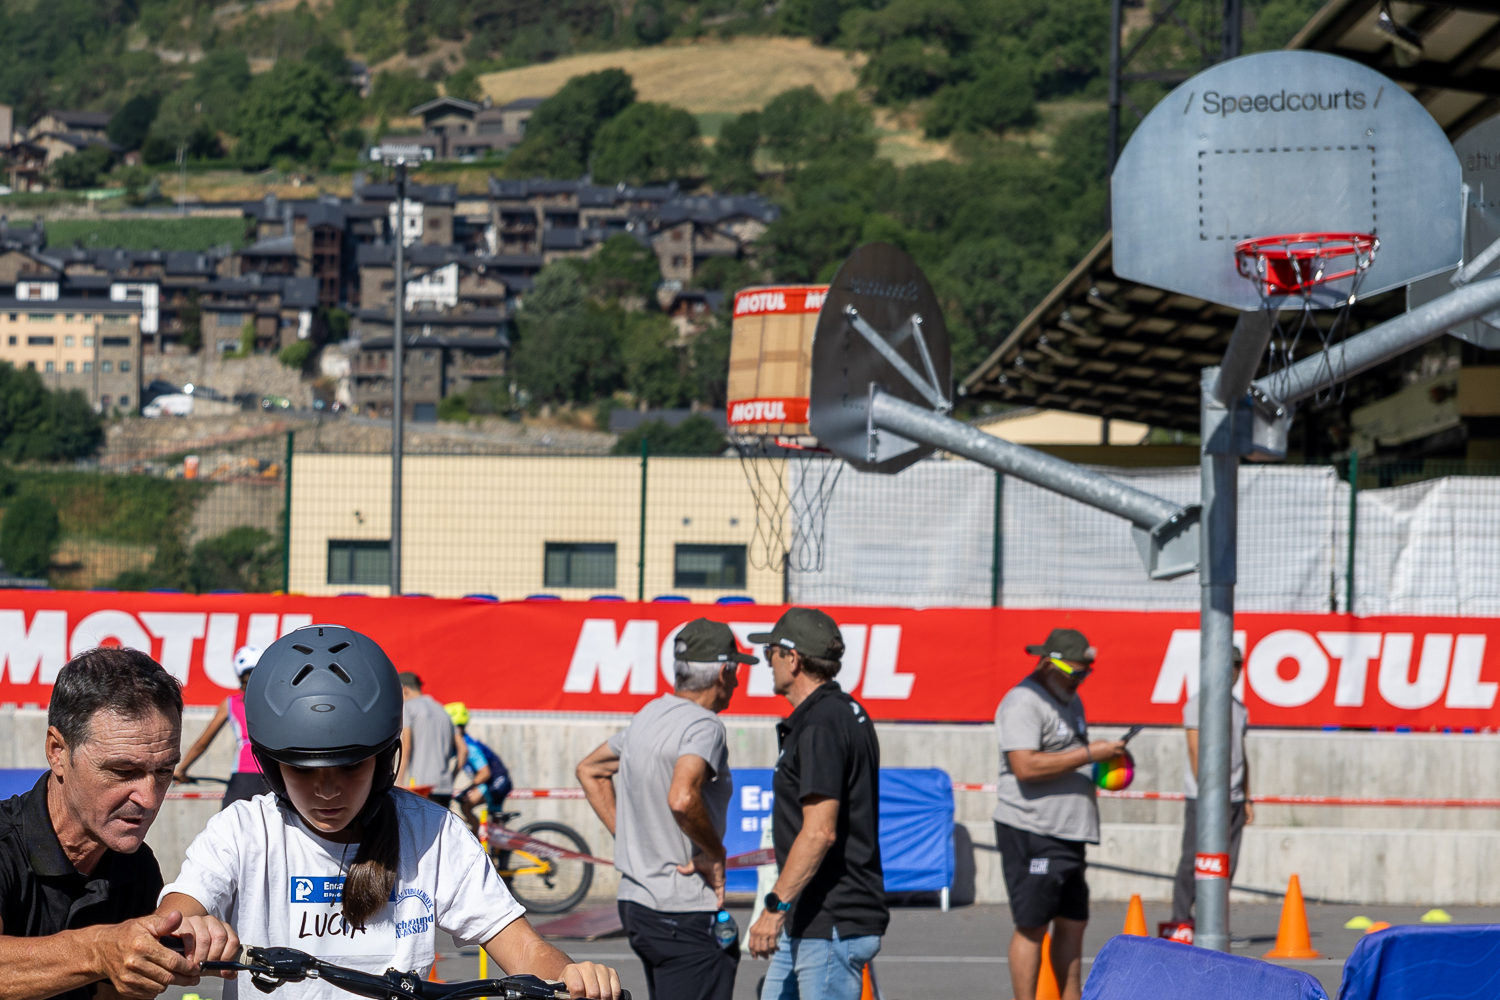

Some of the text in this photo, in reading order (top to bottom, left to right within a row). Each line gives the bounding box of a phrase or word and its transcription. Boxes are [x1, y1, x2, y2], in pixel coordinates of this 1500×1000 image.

[1202, 87, 1366, 119] Speedcourts
[736, 292, 786, 315] MOTUL
[731, 401, 787, 422] MOTUL
